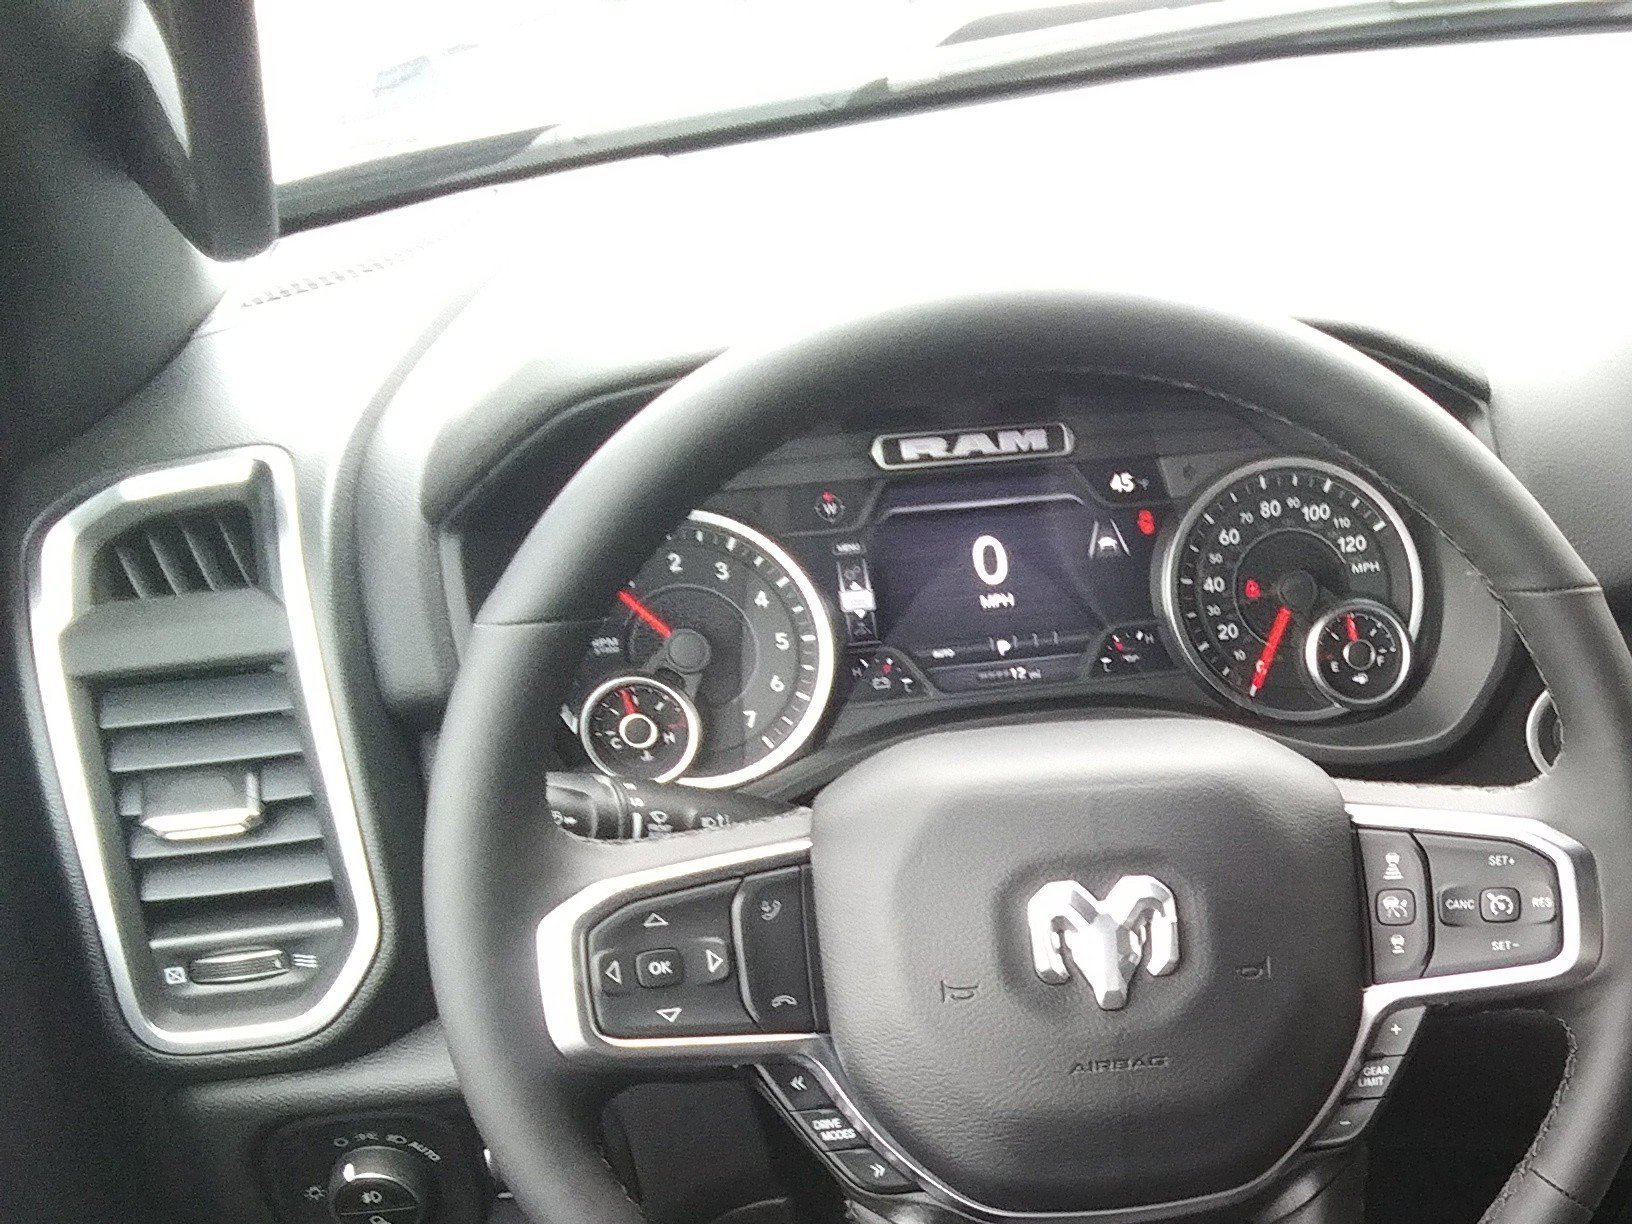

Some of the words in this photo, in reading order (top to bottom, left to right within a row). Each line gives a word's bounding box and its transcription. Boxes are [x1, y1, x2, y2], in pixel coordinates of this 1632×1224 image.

[899, 428, 1050, 461] RAM
[1260, 500, 1281, 518] 80
[1302, 504, 1331, 521] 100
[1240, 512, 1254, 525] 70
[1334, 516, 1351, 529] 110
[1219, 528, 1241, 546] 60
[1337, 535, 1367, 553] 120
[667, 554, 682, 572] 2
[972, 535, 1008, 585] 0
[715, 562, 730, 581] 3
[1351, 562, 1380, 575] MPH
[1203, 577, 1226, 593] 40
[755, 590, 769, 608] 4
[979, 593, 1015, 610] MPH
[1207, 605, 1222, 617] 30
[1217, 623, 1239, 640] 20
[775, 633, 789, 650] 5
[1233, 650, 1247, 661] 10
[771, 676, 785, 692] 6
[744, 710, 756, 728] 7
[1445, 900, 1475, 911] CANC
[1532, 897, 1552, 908] RES
[648, 960, 673, 975] OK
[1068, 1055, 1170, 1076] AIRBAG
[1363, 1065, 1390, 1077] GEAR
[1357, 1076, 1385, 1088] LIMIT
[813, 1118, 842, 1130] DRIVE
[820, 1129, 856, 1141] MODES
